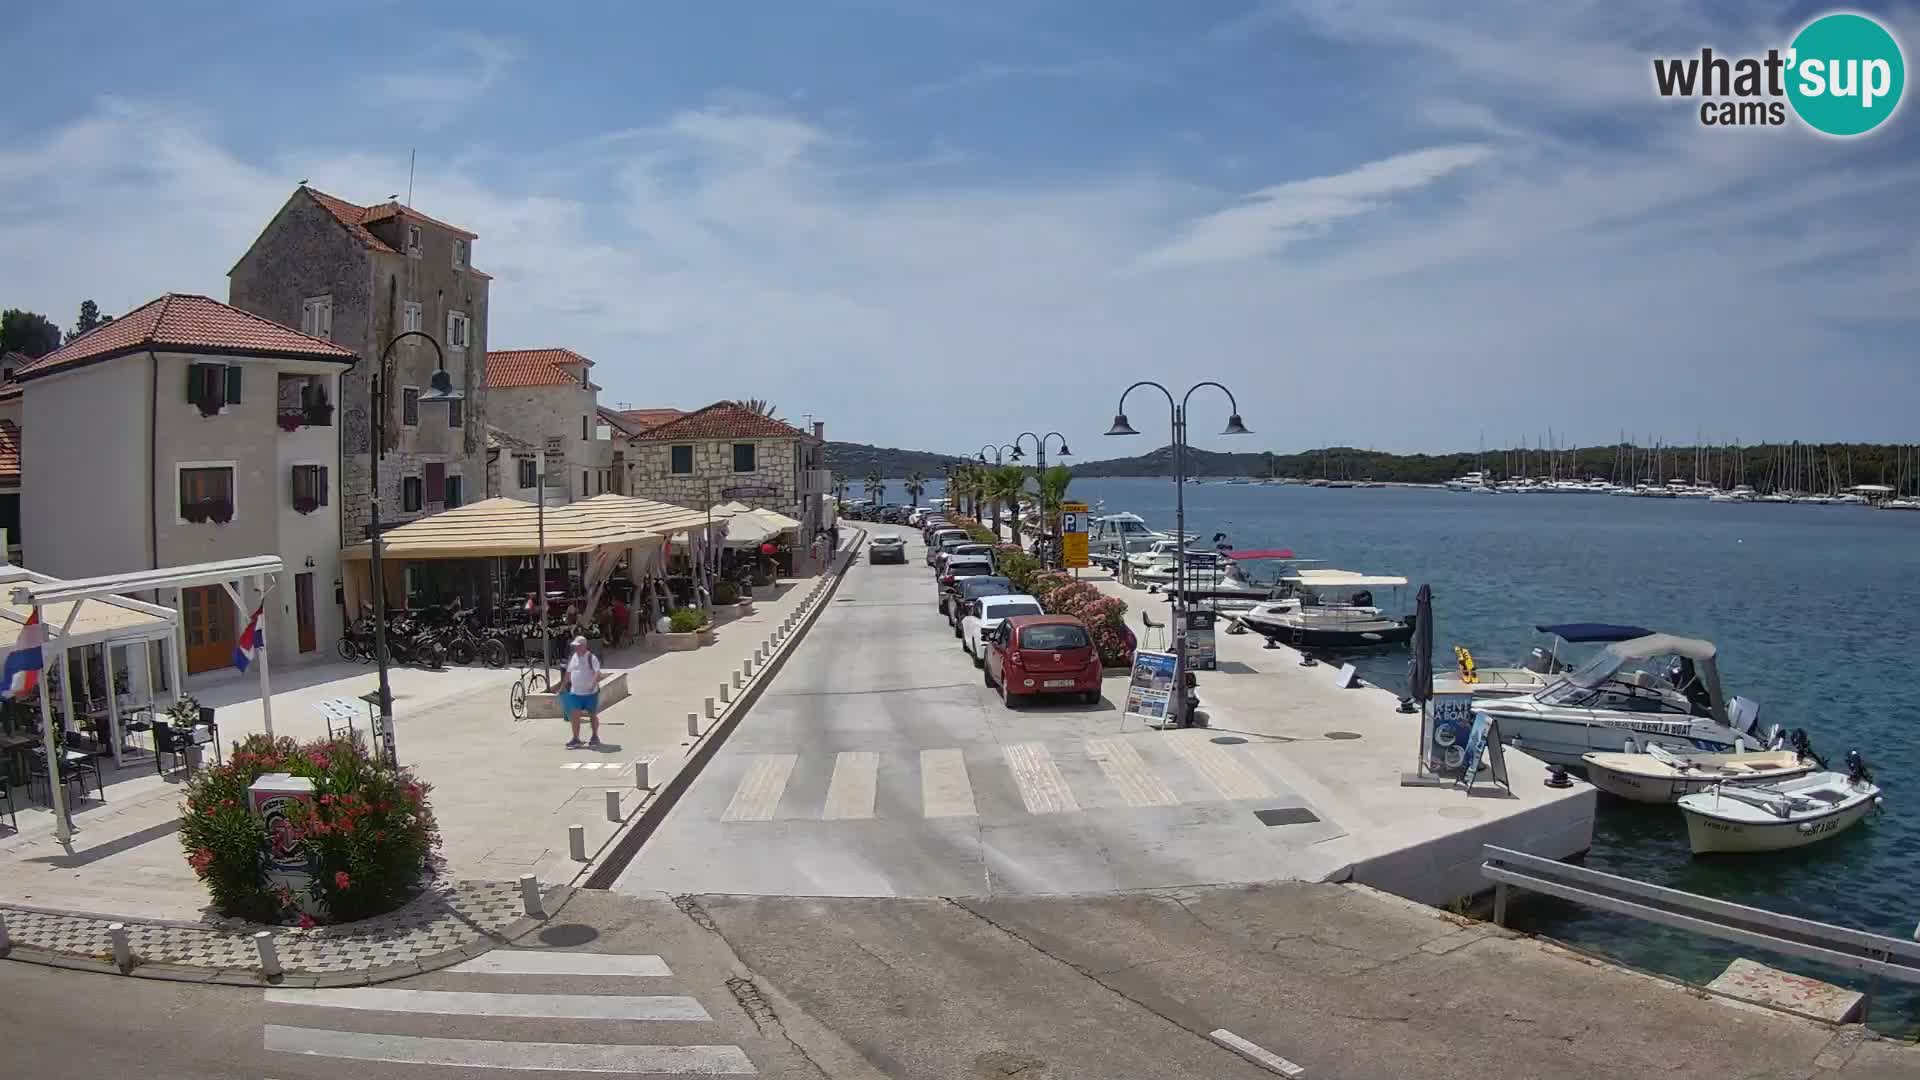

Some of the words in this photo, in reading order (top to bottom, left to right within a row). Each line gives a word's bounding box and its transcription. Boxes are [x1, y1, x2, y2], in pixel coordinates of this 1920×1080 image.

[1064, 514, 1076, 531] P
[1435, 699, 1469, 712] RENT
[1433, 711, 1441, 720] A
[1641, 721, 1663, 732] RENT
[1664, 723, 1670, 733] A
[1671, 724, 1692, 736] BOAT
